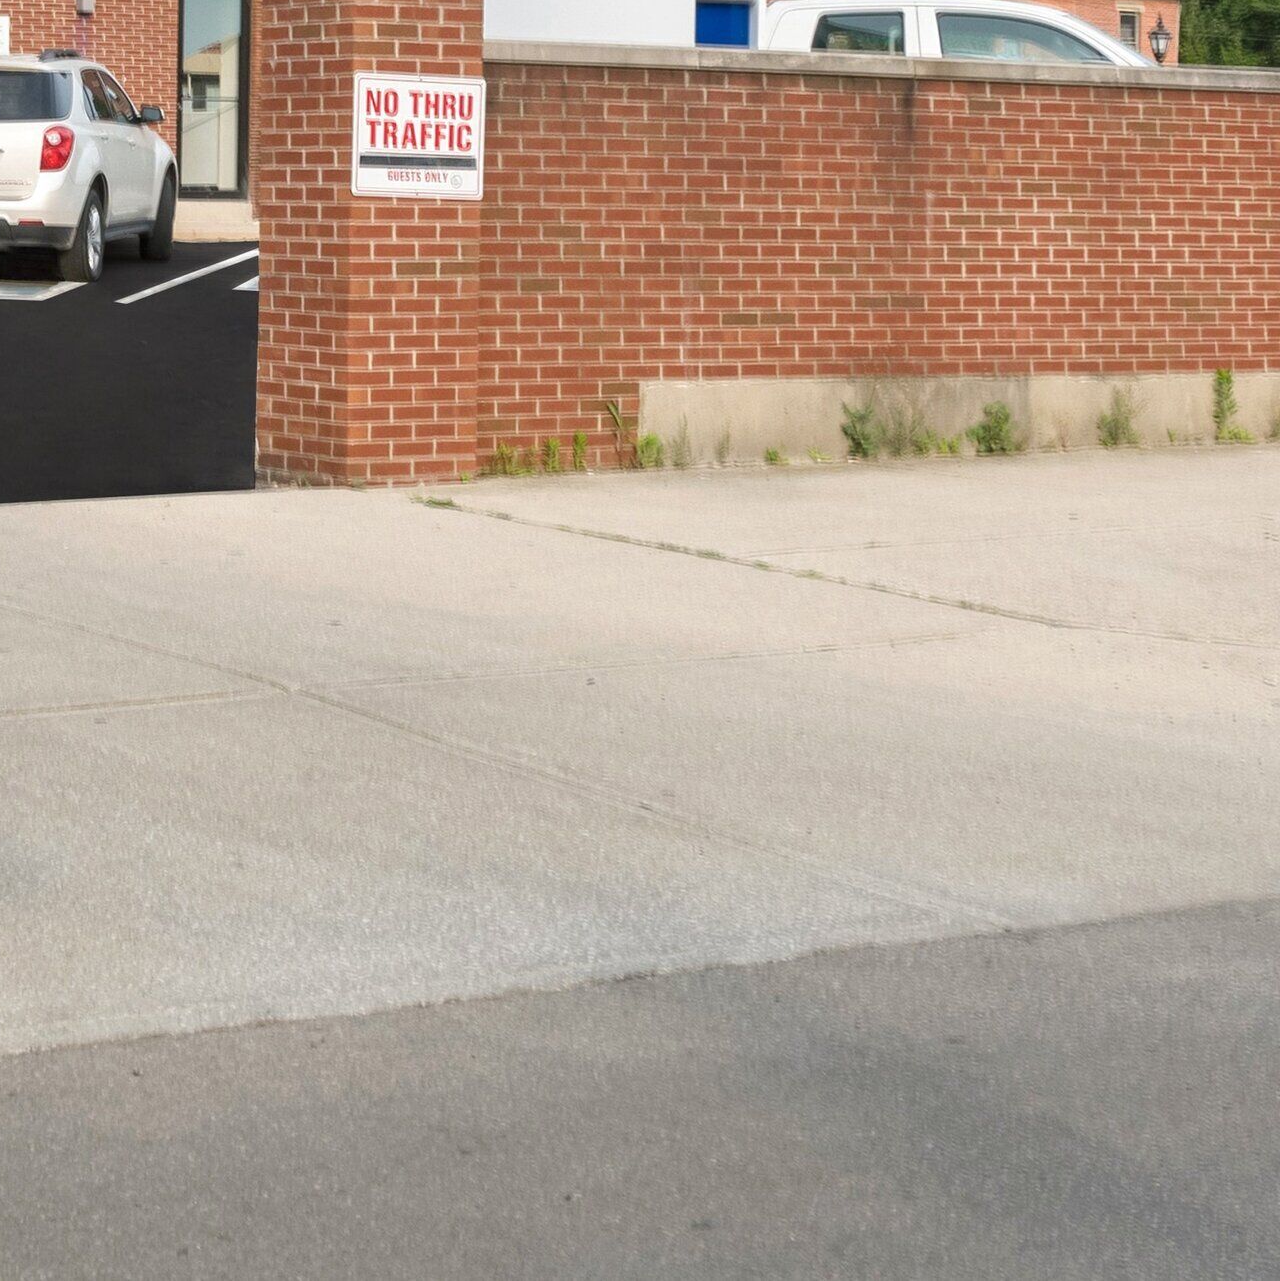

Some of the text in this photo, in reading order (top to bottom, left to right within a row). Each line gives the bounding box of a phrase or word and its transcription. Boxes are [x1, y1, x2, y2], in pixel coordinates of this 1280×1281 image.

[366, 88, 473, 120] NO THRU
[366, 118, 472, 152] TRAFFIC
[387, 171, 449, 183] GUESTS ONLY
